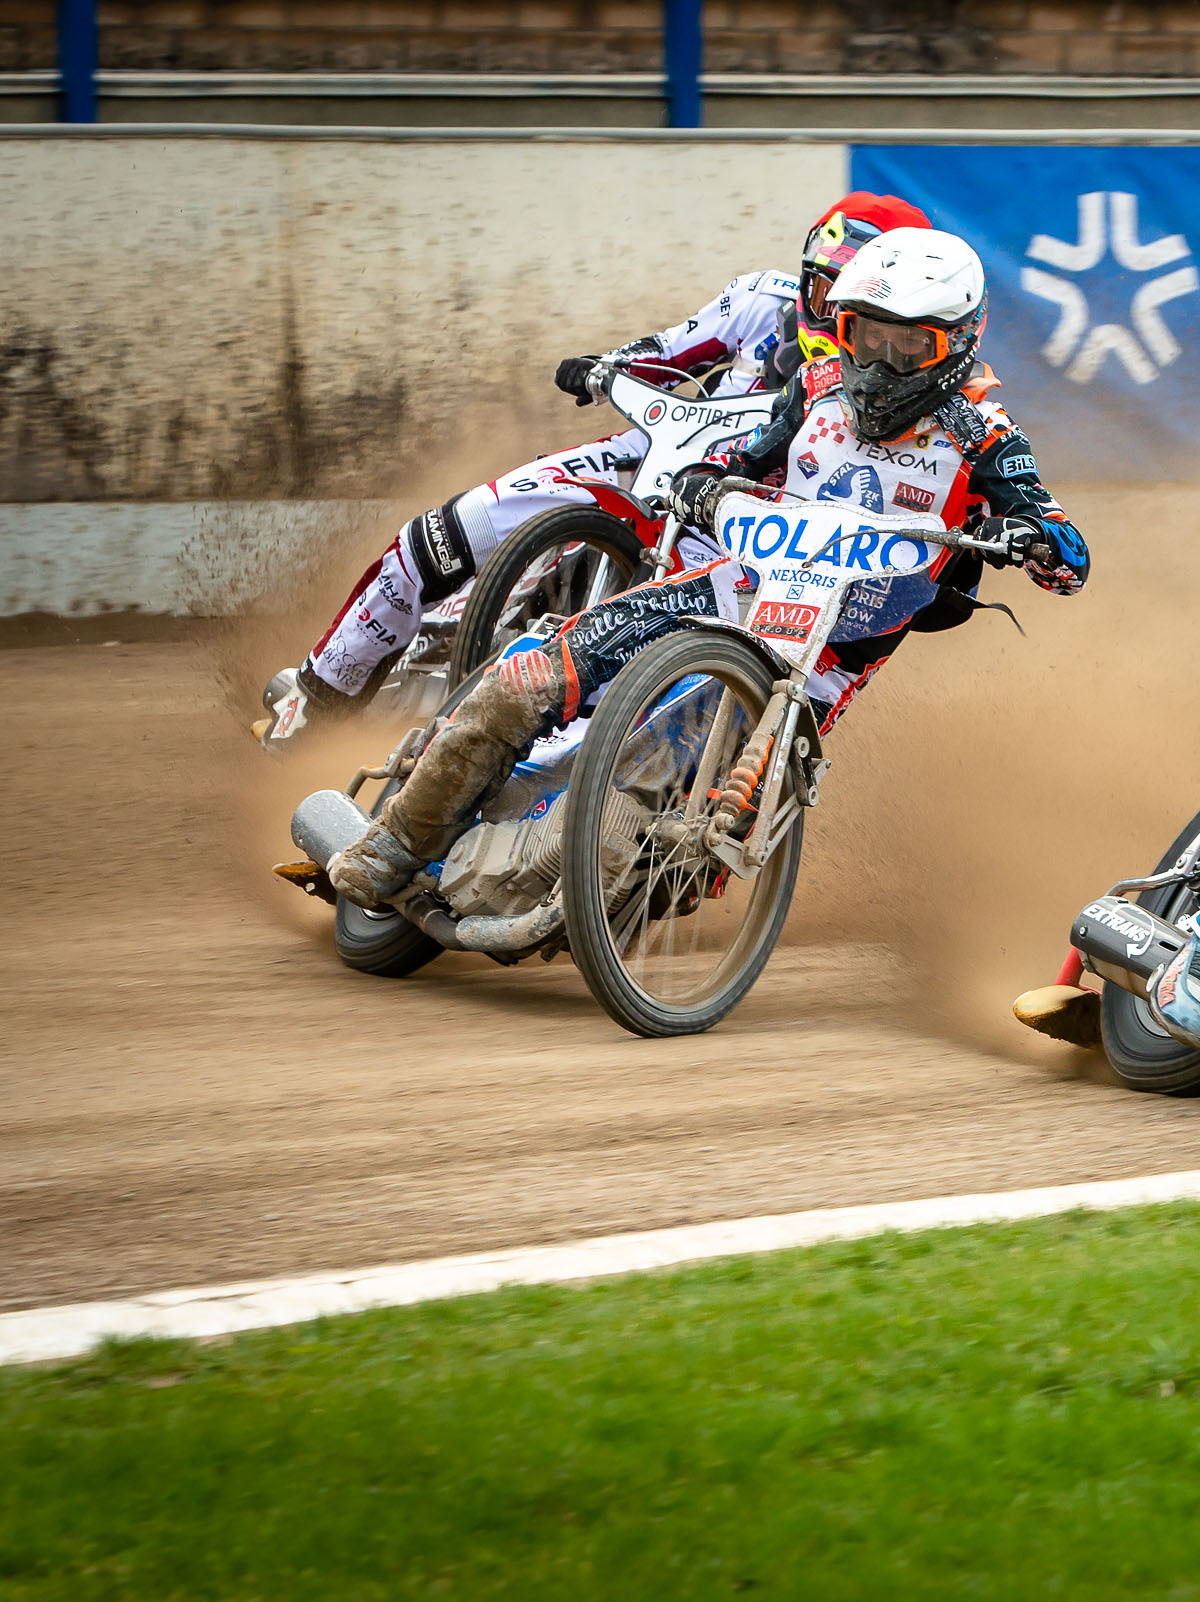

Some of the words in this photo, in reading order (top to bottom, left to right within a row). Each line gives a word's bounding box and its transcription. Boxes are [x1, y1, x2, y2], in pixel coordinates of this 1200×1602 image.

[813, 364, 834, 381] DAN
[671, 405, 745, 429] OPTIBET
[856, 438, 937, 476] TEXOM
[830, 463, 853, 487] STAL
[897, 485, 934, 506] AMD
[723, 514, 929, 572] STOLARO
[769, 568, 838, 589] NEXORIS
[572, 611, 627, 649] Palle
[631, 590, 708, 619] Phillip
[755, 605, 816, 627] AMD
[753, 625, 808, 638] GROUP
[1083, 903, 1150, 942] EXTRANS
